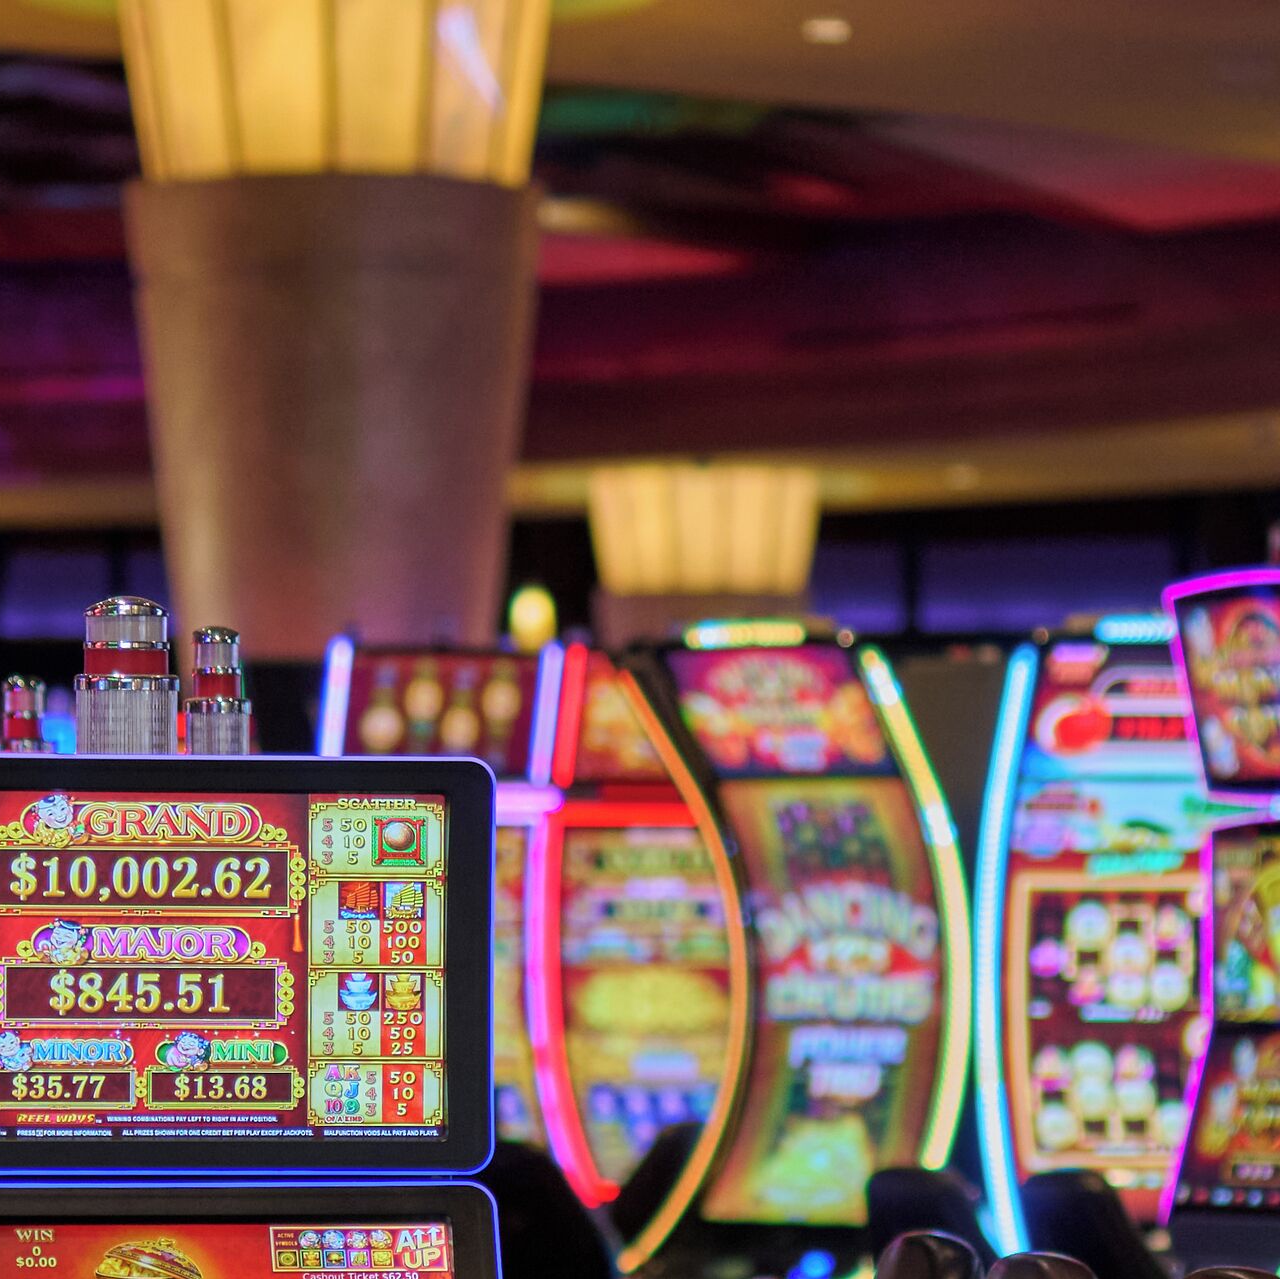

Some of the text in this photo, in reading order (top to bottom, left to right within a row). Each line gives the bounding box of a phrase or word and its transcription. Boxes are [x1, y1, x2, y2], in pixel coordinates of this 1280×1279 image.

[337, 798, 418, 811] SCATTER
[79, 803, 250, 841] GRAND
[322, 818, 368, 832] 5 50
[322, 834, 366, 848] 4 10
[322, 850, 358, 865] 3 5
[10, 852, 272, 902] $10,002.62
[323, 920, 423, 934] 5 50 500
[94, 927, 234, 961] MAJOR
[323, 935, 421, 949] 4 10 100
[323, 950, 415, 965] 3 5 50
[50, 969, 231, 1016] $845.51
[323, 1011, 423, 1025] 5 50 250
[323, 1026, 417, 1041] 4 10 50
[32, 1038, 124, 1063] MINOR
[210, 1039, 274, 1062] MINI
[323, 1042, 414, 1056] 3 5 25
[366, 1071, 417, 1085] 5 50
[11, 1073, 106, 1101] $35.77
[174, 1073, 269, 1101] $13.68
[365, 1087, 415, 1101] 4 10
[365, 1102, 408, 1117] 3 5
[16, 1114, 52, 1123] REEL
[338, 1115, 344, 1123] A
[345, 1115, 363, 1123] KIND
[15, 1228, 56, 1243] WIN
[31, 1246, 42, 1257] 0
[402, 1247, 442, 1270] UP
[16, 1256, 58, 1268] $0.00
